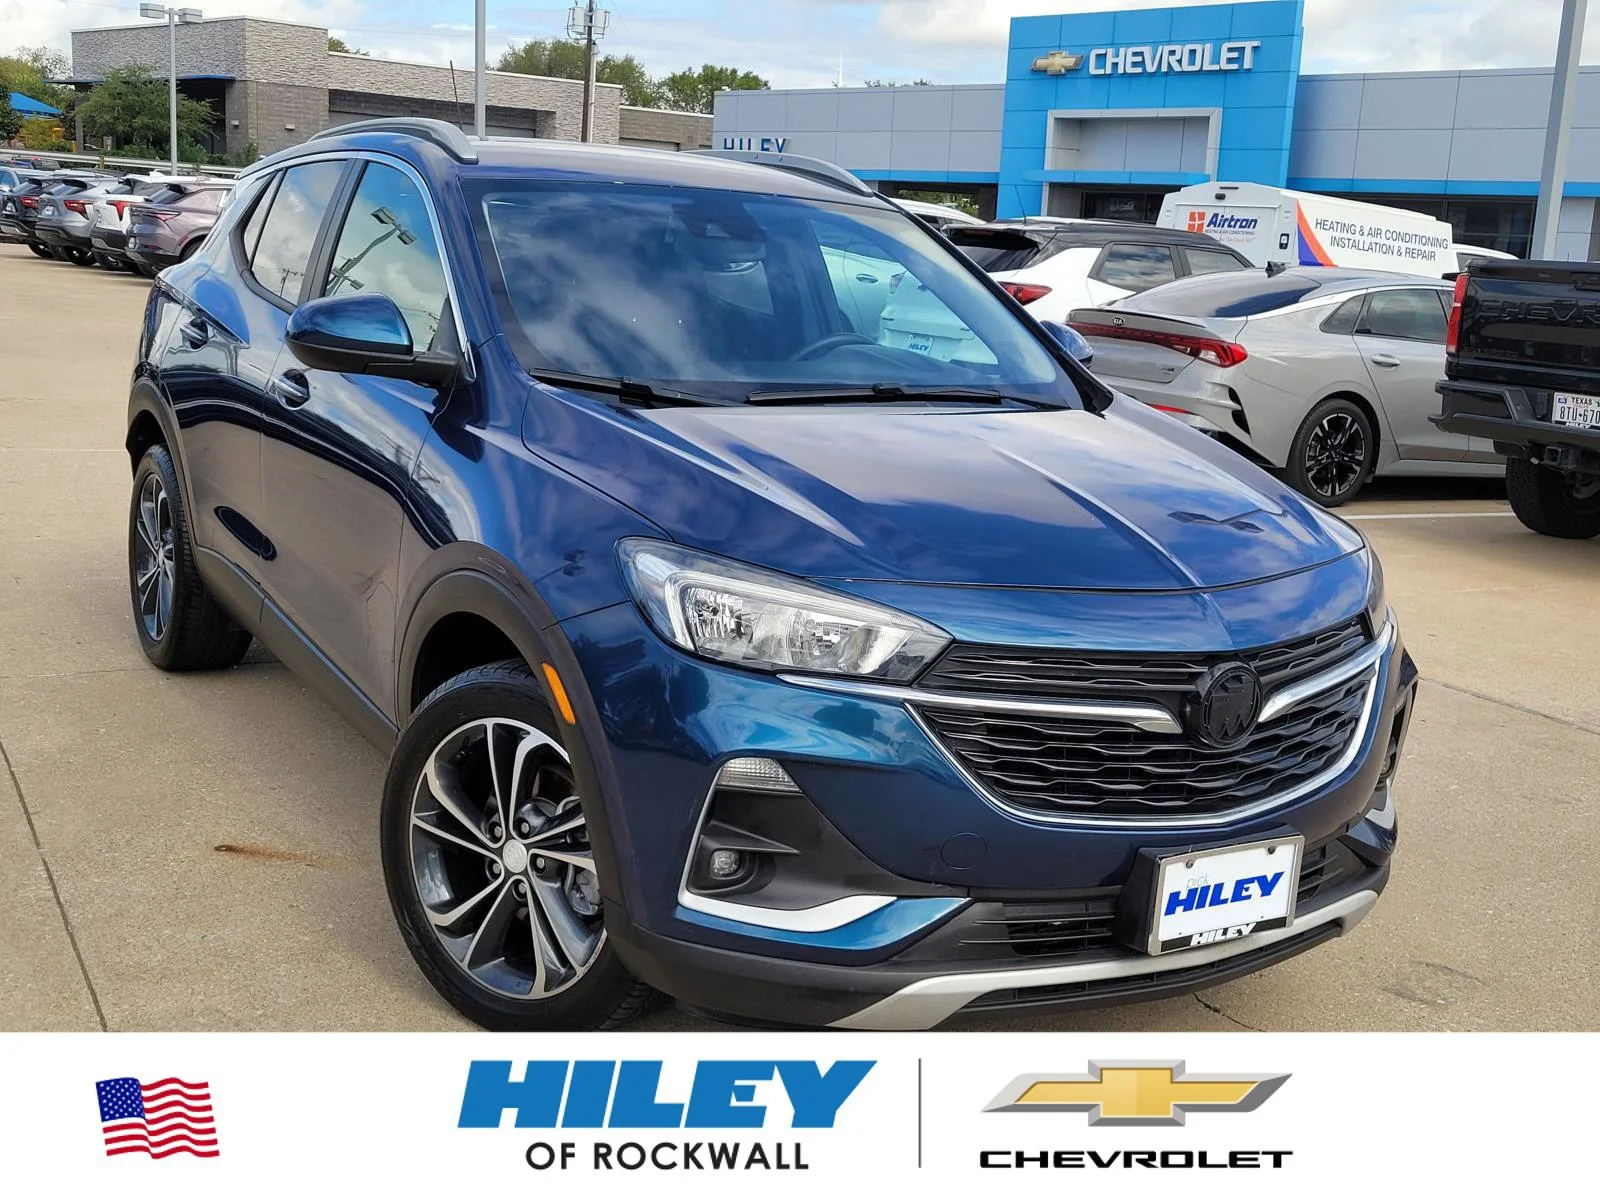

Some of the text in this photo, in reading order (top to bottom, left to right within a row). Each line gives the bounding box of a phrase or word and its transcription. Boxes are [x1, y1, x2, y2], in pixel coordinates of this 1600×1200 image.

[1089, 41, 1261, 75] CHEVROLET
[1206, 212, 1258, 229] Airtron
[1315, 218, 1449, 249] HEATING & AIR CONDITIONING
[1330, 235, 1436, 260] INSTALLATION & REPAIR
[908, 343, 929, 351] HILEY
[1571, 397, 1592, 405] TEXAS
[1164, 871, 1285, 916] HILEY
[1190, 923, 1257, 947] HILEY
